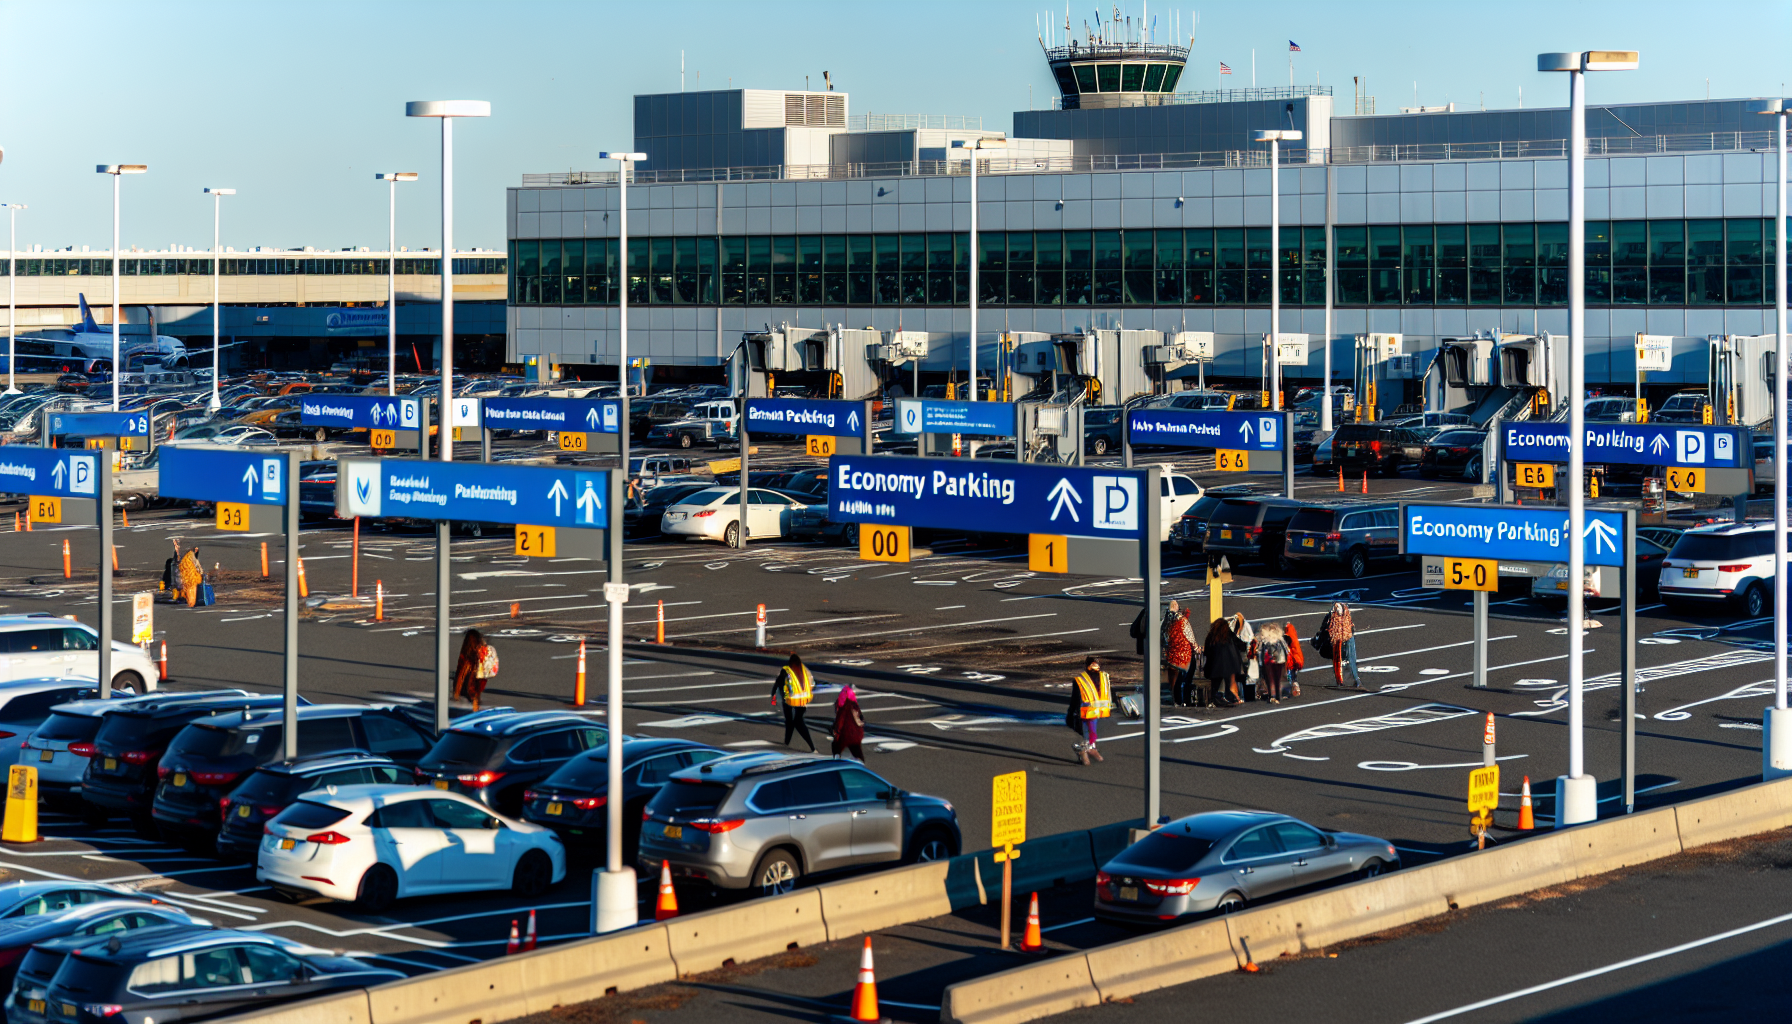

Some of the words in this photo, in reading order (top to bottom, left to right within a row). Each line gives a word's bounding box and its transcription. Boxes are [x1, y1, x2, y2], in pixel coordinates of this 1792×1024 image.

[1684, 434, 1701, 462] P
[838, 464, 926, 500] Economy
[932, 470, 1016, 505] Parking
[1104, 485, 1130, 523] P
[519, 531, 545, 553] 21
[872, 529, 899, 557] 00
[1411, 515, 1494, 544] Economy
[1045, 541, 1054, 568] 1
[1451, 561, 1487, 588] 5-0
